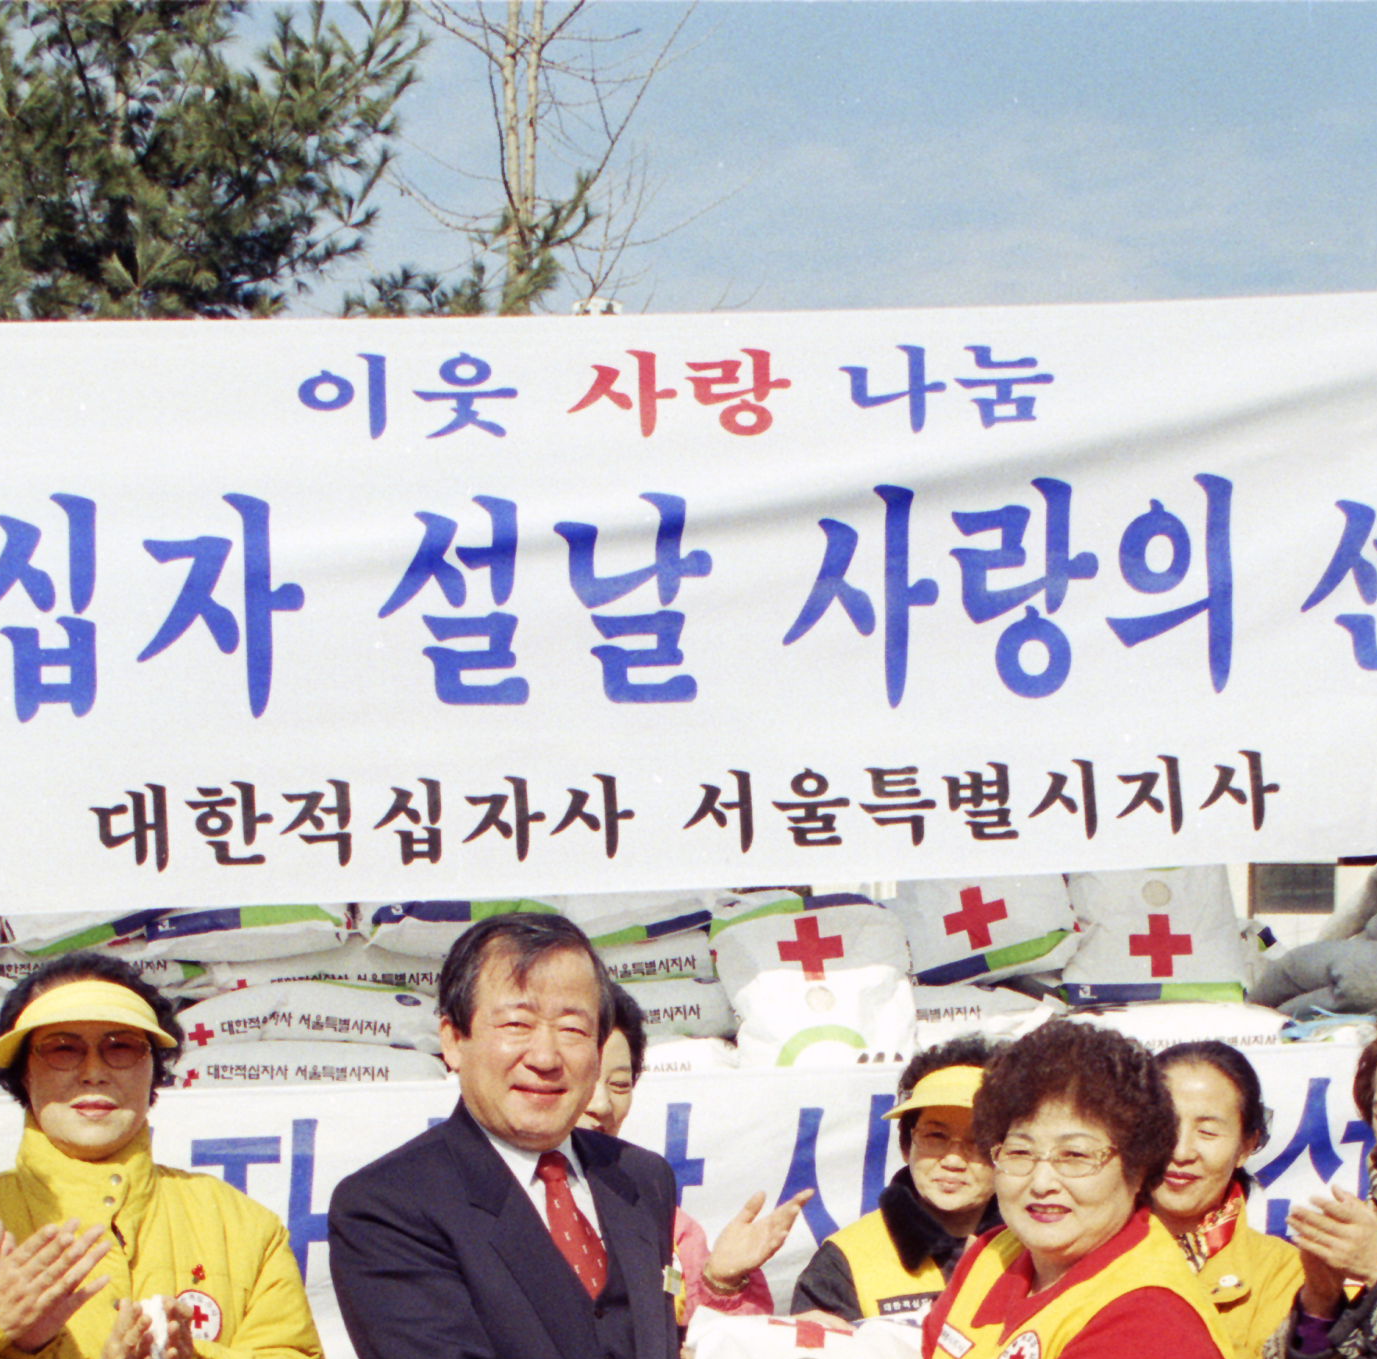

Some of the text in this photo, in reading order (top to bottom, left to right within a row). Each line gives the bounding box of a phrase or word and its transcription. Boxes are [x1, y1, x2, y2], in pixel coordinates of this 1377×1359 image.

[298, 343, 1054, 439] 이웃 사랑 나눔
[378, 491, 713, 706] 설날
[783, 473, 1234, 709] 사랑의
[90, 750, 1281, 873] 대한적십자사 서울특별시지사
[207, 1064, 390, 1082] 대한적십자사 서울특별시지사
[299, 1013, 392, 1038] 서울특별시지사
